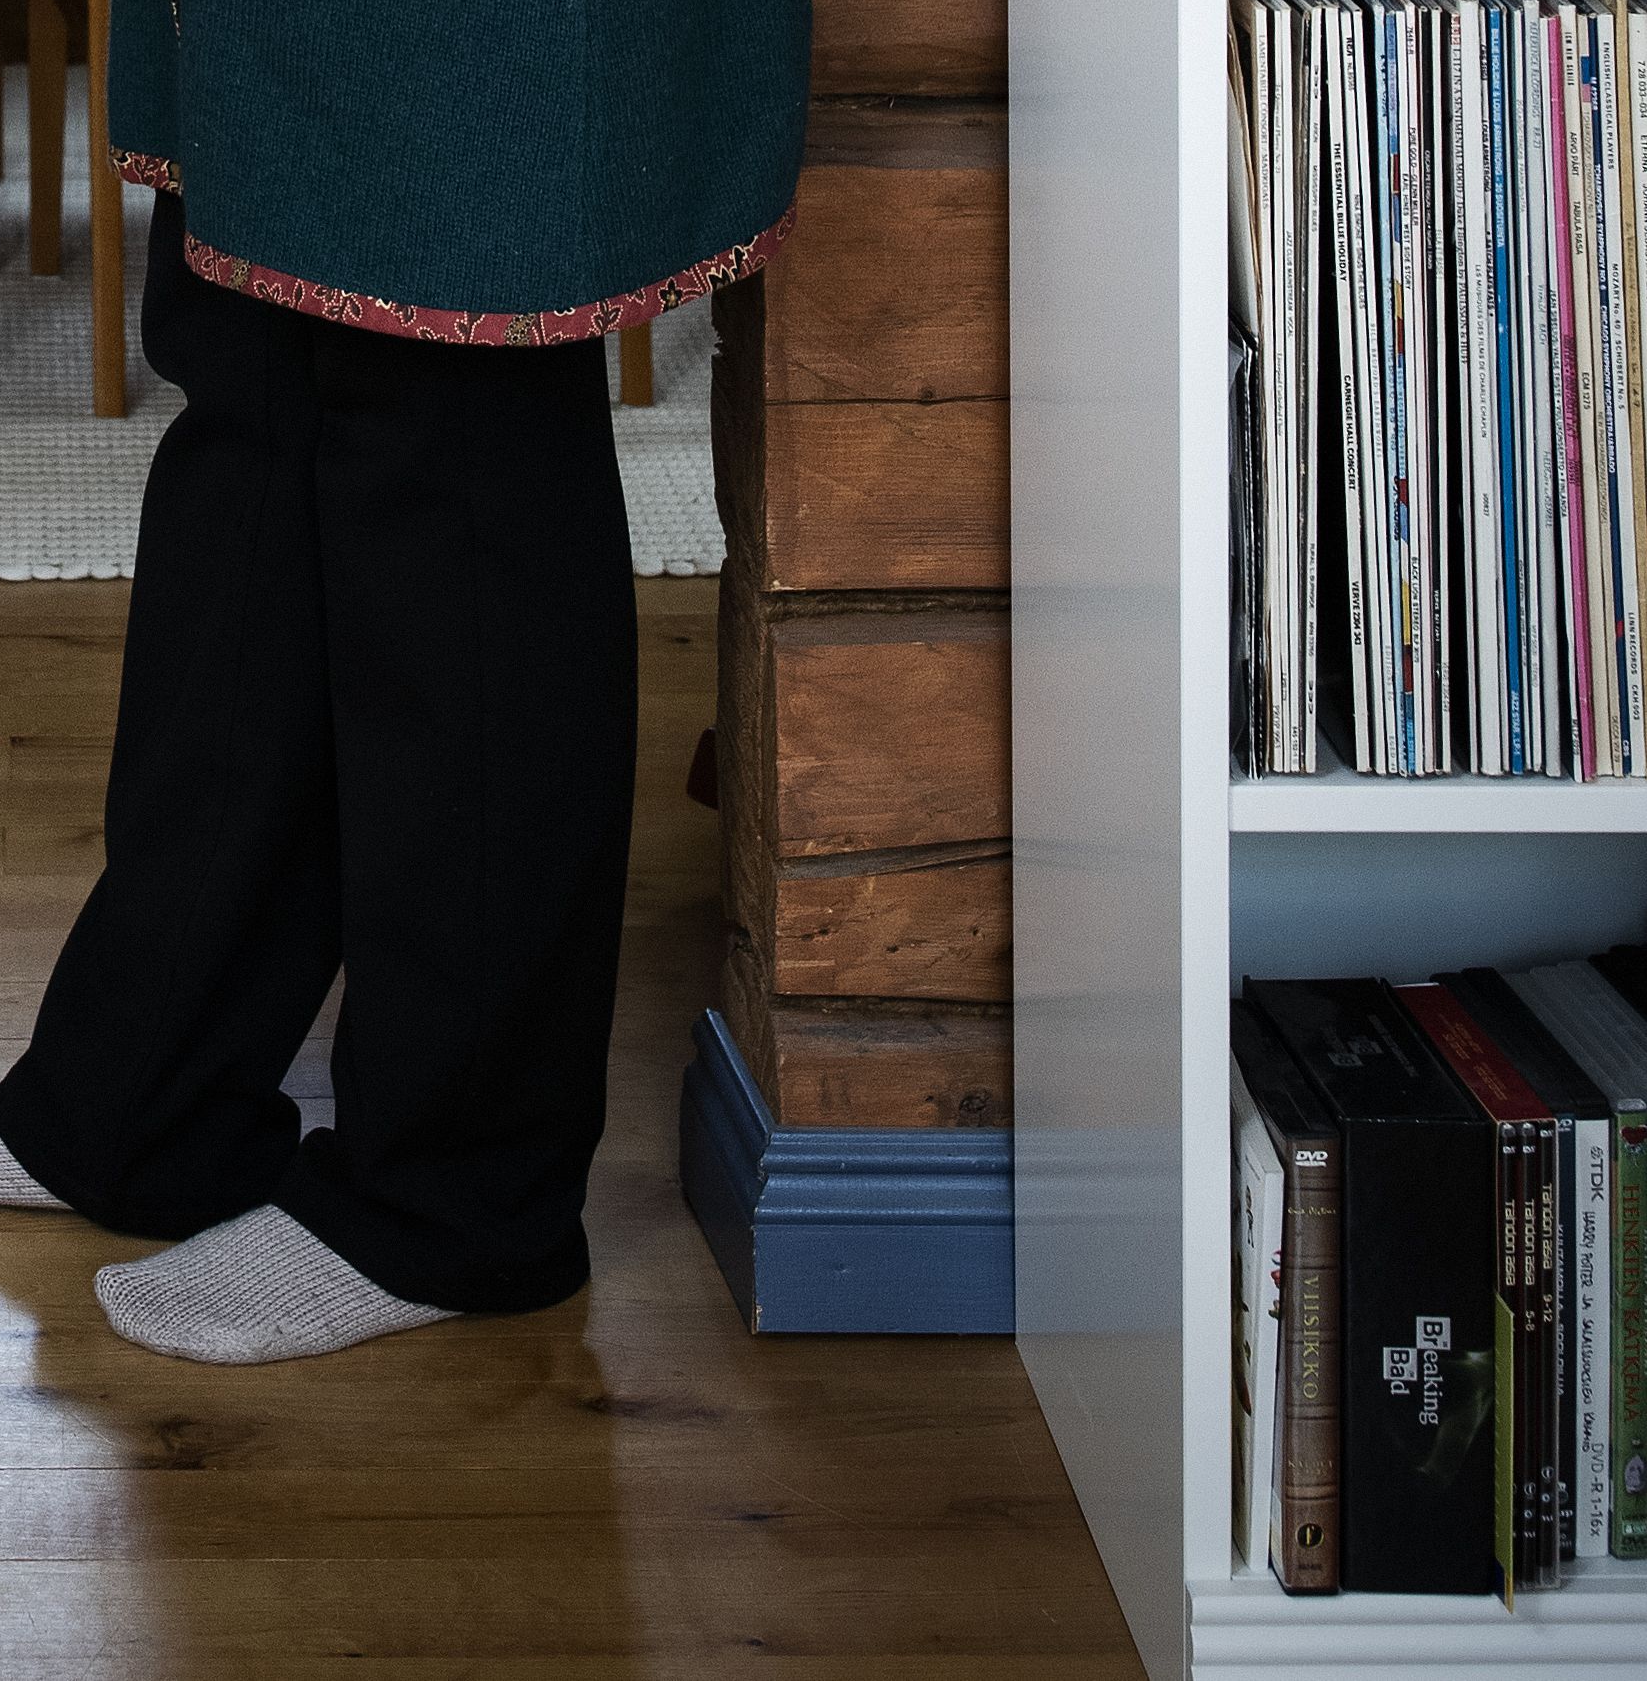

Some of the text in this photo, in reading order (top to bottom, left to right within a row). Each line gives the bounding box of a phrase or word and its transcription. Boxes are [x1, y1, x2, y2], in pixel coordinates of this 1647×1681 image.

[1258, 34, 1269, 210] LAMENTABILE CONSORT MADRIGALS
[1603, 42, 1615, 170] ENGLISH CLASSICAL PLAYERS
[1571, 131, 1580, 177] ARVO PÄRT
[1334, 143, 1346, 281] THE ESSENTIAL BILLIE HOLIDAY
[1574, 201, 1583, 256] TABULA RASA
[1476, 279, 1484, 319] MUSIQUES
[1612, 263, 1620, 300] MOZART
[1614, 319, 1622, 330] 40
[1477, 337, 1485, 359] FILMS
[1478, 361, 1486, 371] DE
[1615, 340, 1624, 385] SCHUBERT
[1479, 372, 1487, 404] CHARLIE
[1582, 372, 1591, 410] ECM 1275
[1617, 389, 1625, 403] No.
[1344, 375, 1356, 490] CARNEGIE HALL CONCERT
[1480, 406, 1488, 438] CHAPLIN
[1352, 581, 1362, 645] VERVE 2304 343
[1628, 613, 1636, 633] LINN
[1629, 634, 1638, 675] RECORDS
[1631, 685, 1639, 703] CKH
[1295, 1150, 1329, 1161] DVD
[1591, 1162, 1604, 1203] TDK
[1580, 1211, 1595, 1248] HARRY
[1580, 1252, 1593, 1288] POTTER
[1543, 1294, 1553, 1323] 9-12
[1582, 1294, 1593, 1310] JA
[1303, 1274, 1320, 1400] VIISIKKO
[1525, 1310, 1535, 1332] 5-8
[1391, 1349, 1411, 1396] Bad
[1419, 1321, 1444, 1426] Breaking
[1591, 1442, 1604, 1473] DVD
[1590, 1498, 1604, 1537] 1-16x
